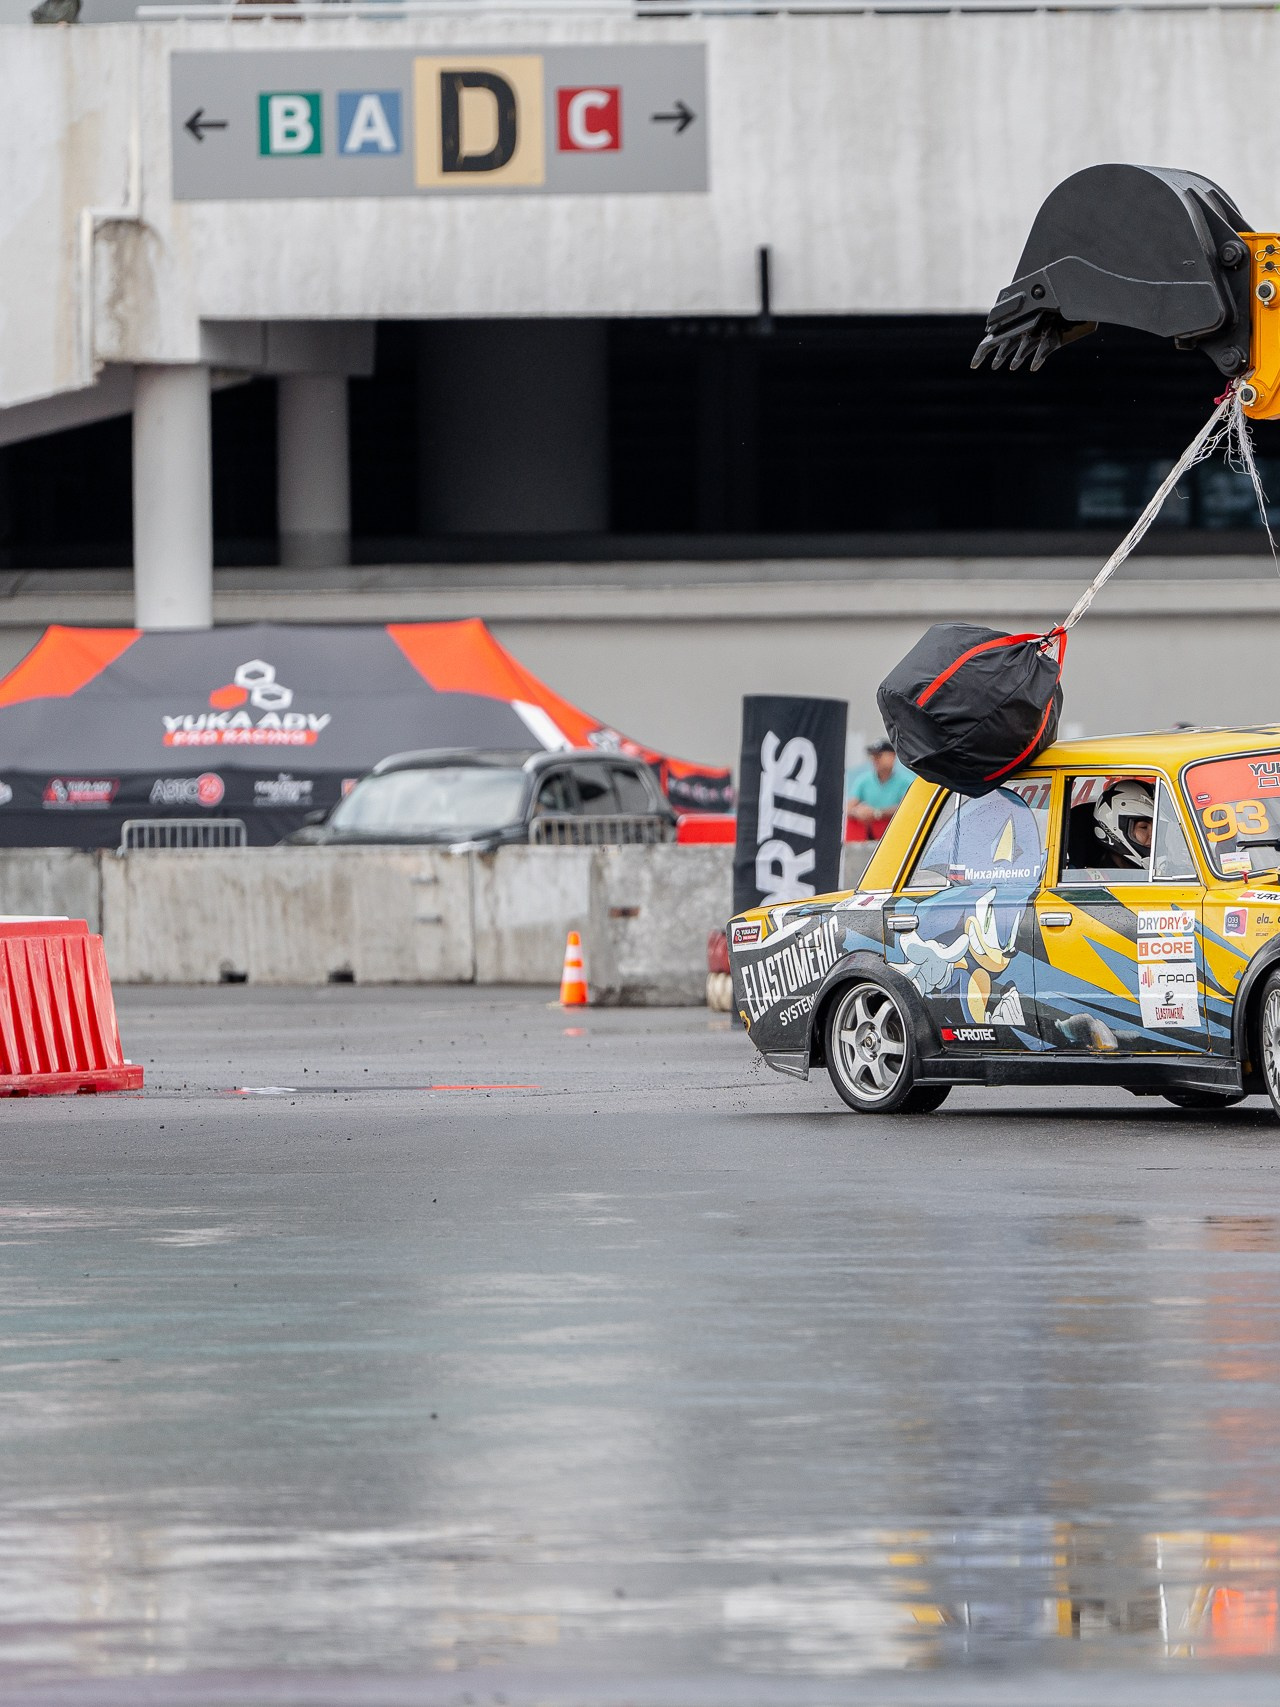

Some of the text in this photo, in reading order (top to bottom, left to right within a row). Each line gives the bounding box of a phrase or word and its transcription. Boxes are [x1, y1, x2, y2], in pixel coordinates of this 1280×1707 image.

[270, 70, 611, 172] B A D C
[162, 711, 332, 732] YUKA ADV
[755, 730, 818, 906] RTIS
[1202, 800, 1270, 843] 93
[965, 866, 1031, 880] Михайленко
[741, 915, 842, 1023] ELASTOMERIC
[1158, 973, 1195, 983] ГРАД
